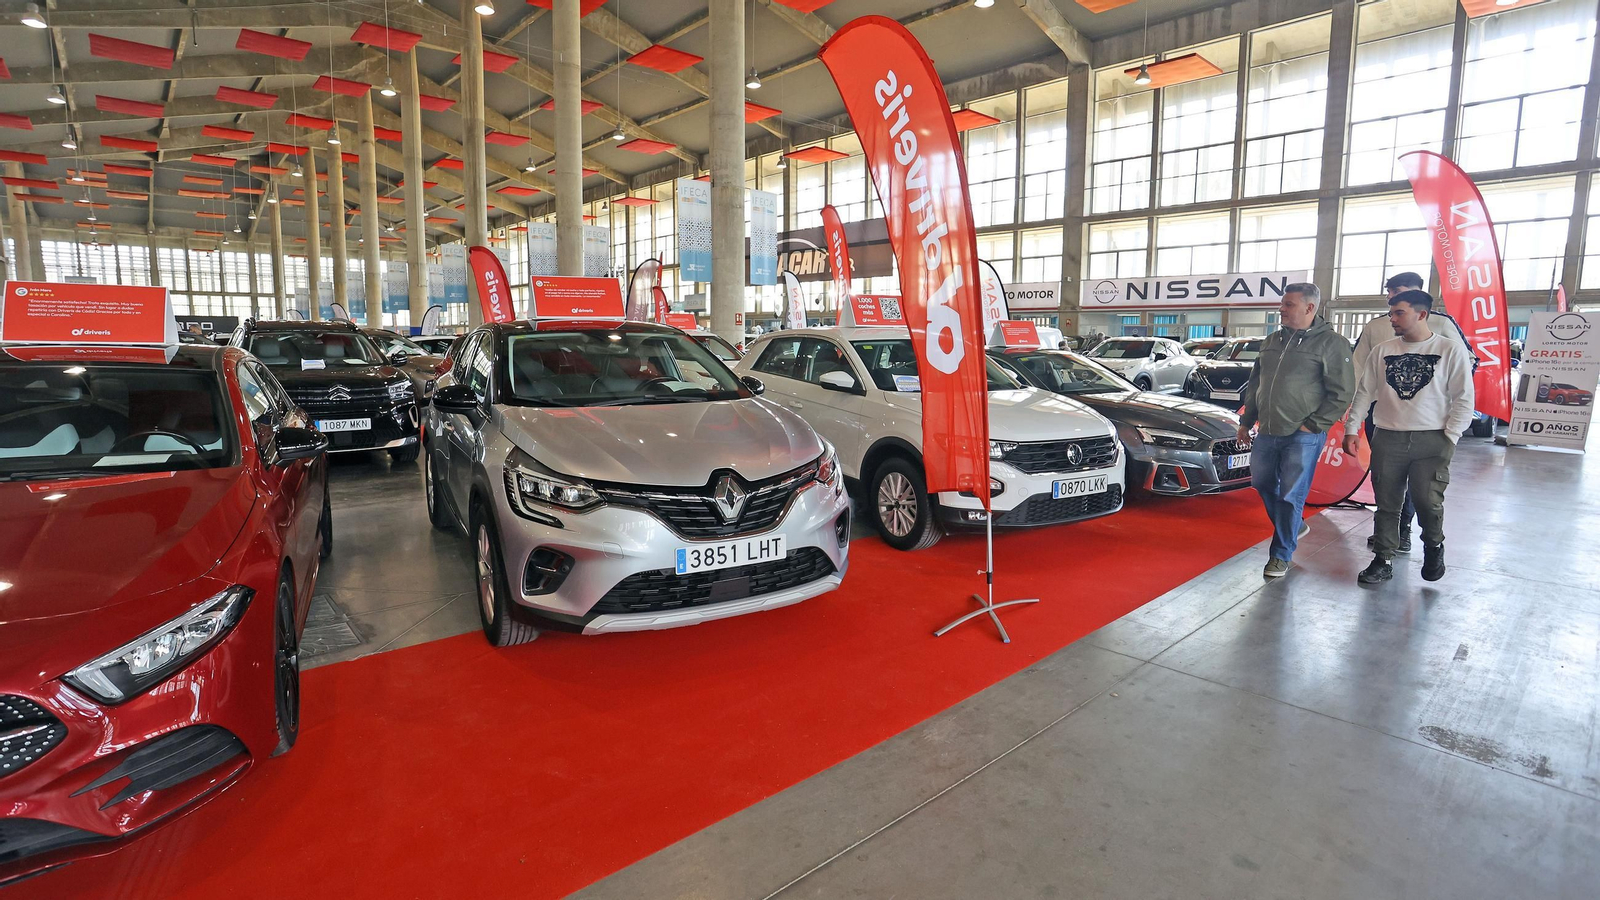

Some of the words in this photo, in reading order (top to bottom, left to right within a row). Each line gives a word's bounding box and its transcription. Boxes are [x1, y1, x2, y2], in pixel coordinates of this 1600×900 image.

[680, 186, 708, 198] IFECA
[752, 196, 775, 207] IFECA
[531, 227, 553, 235] IFECA
[585, 230, 607, 239] IFECA
[788, 249, 828, 276] CAR
[1126, 276, 1288, 300] NISSAN
[1004, 290, 1015, 300] TO
[1016, 290, 1054, 299] MOTOR
[1514, 406, 1553, 414] NISSAN
[324, 421, 347, 430] 1087
[349, 420, 368, 429] MKN
[1523, 421, 1544, 434] 10
[1546, 422, 1579, 433] AÑOS
[1232, 455, 1248, 468] 2717
[1060, 480, 1086, 496] 0870
[1088, 477, 1106, 492] LKK
[690, 544, 737, 568] 3851
[747, 537, 781, 561] LHT
